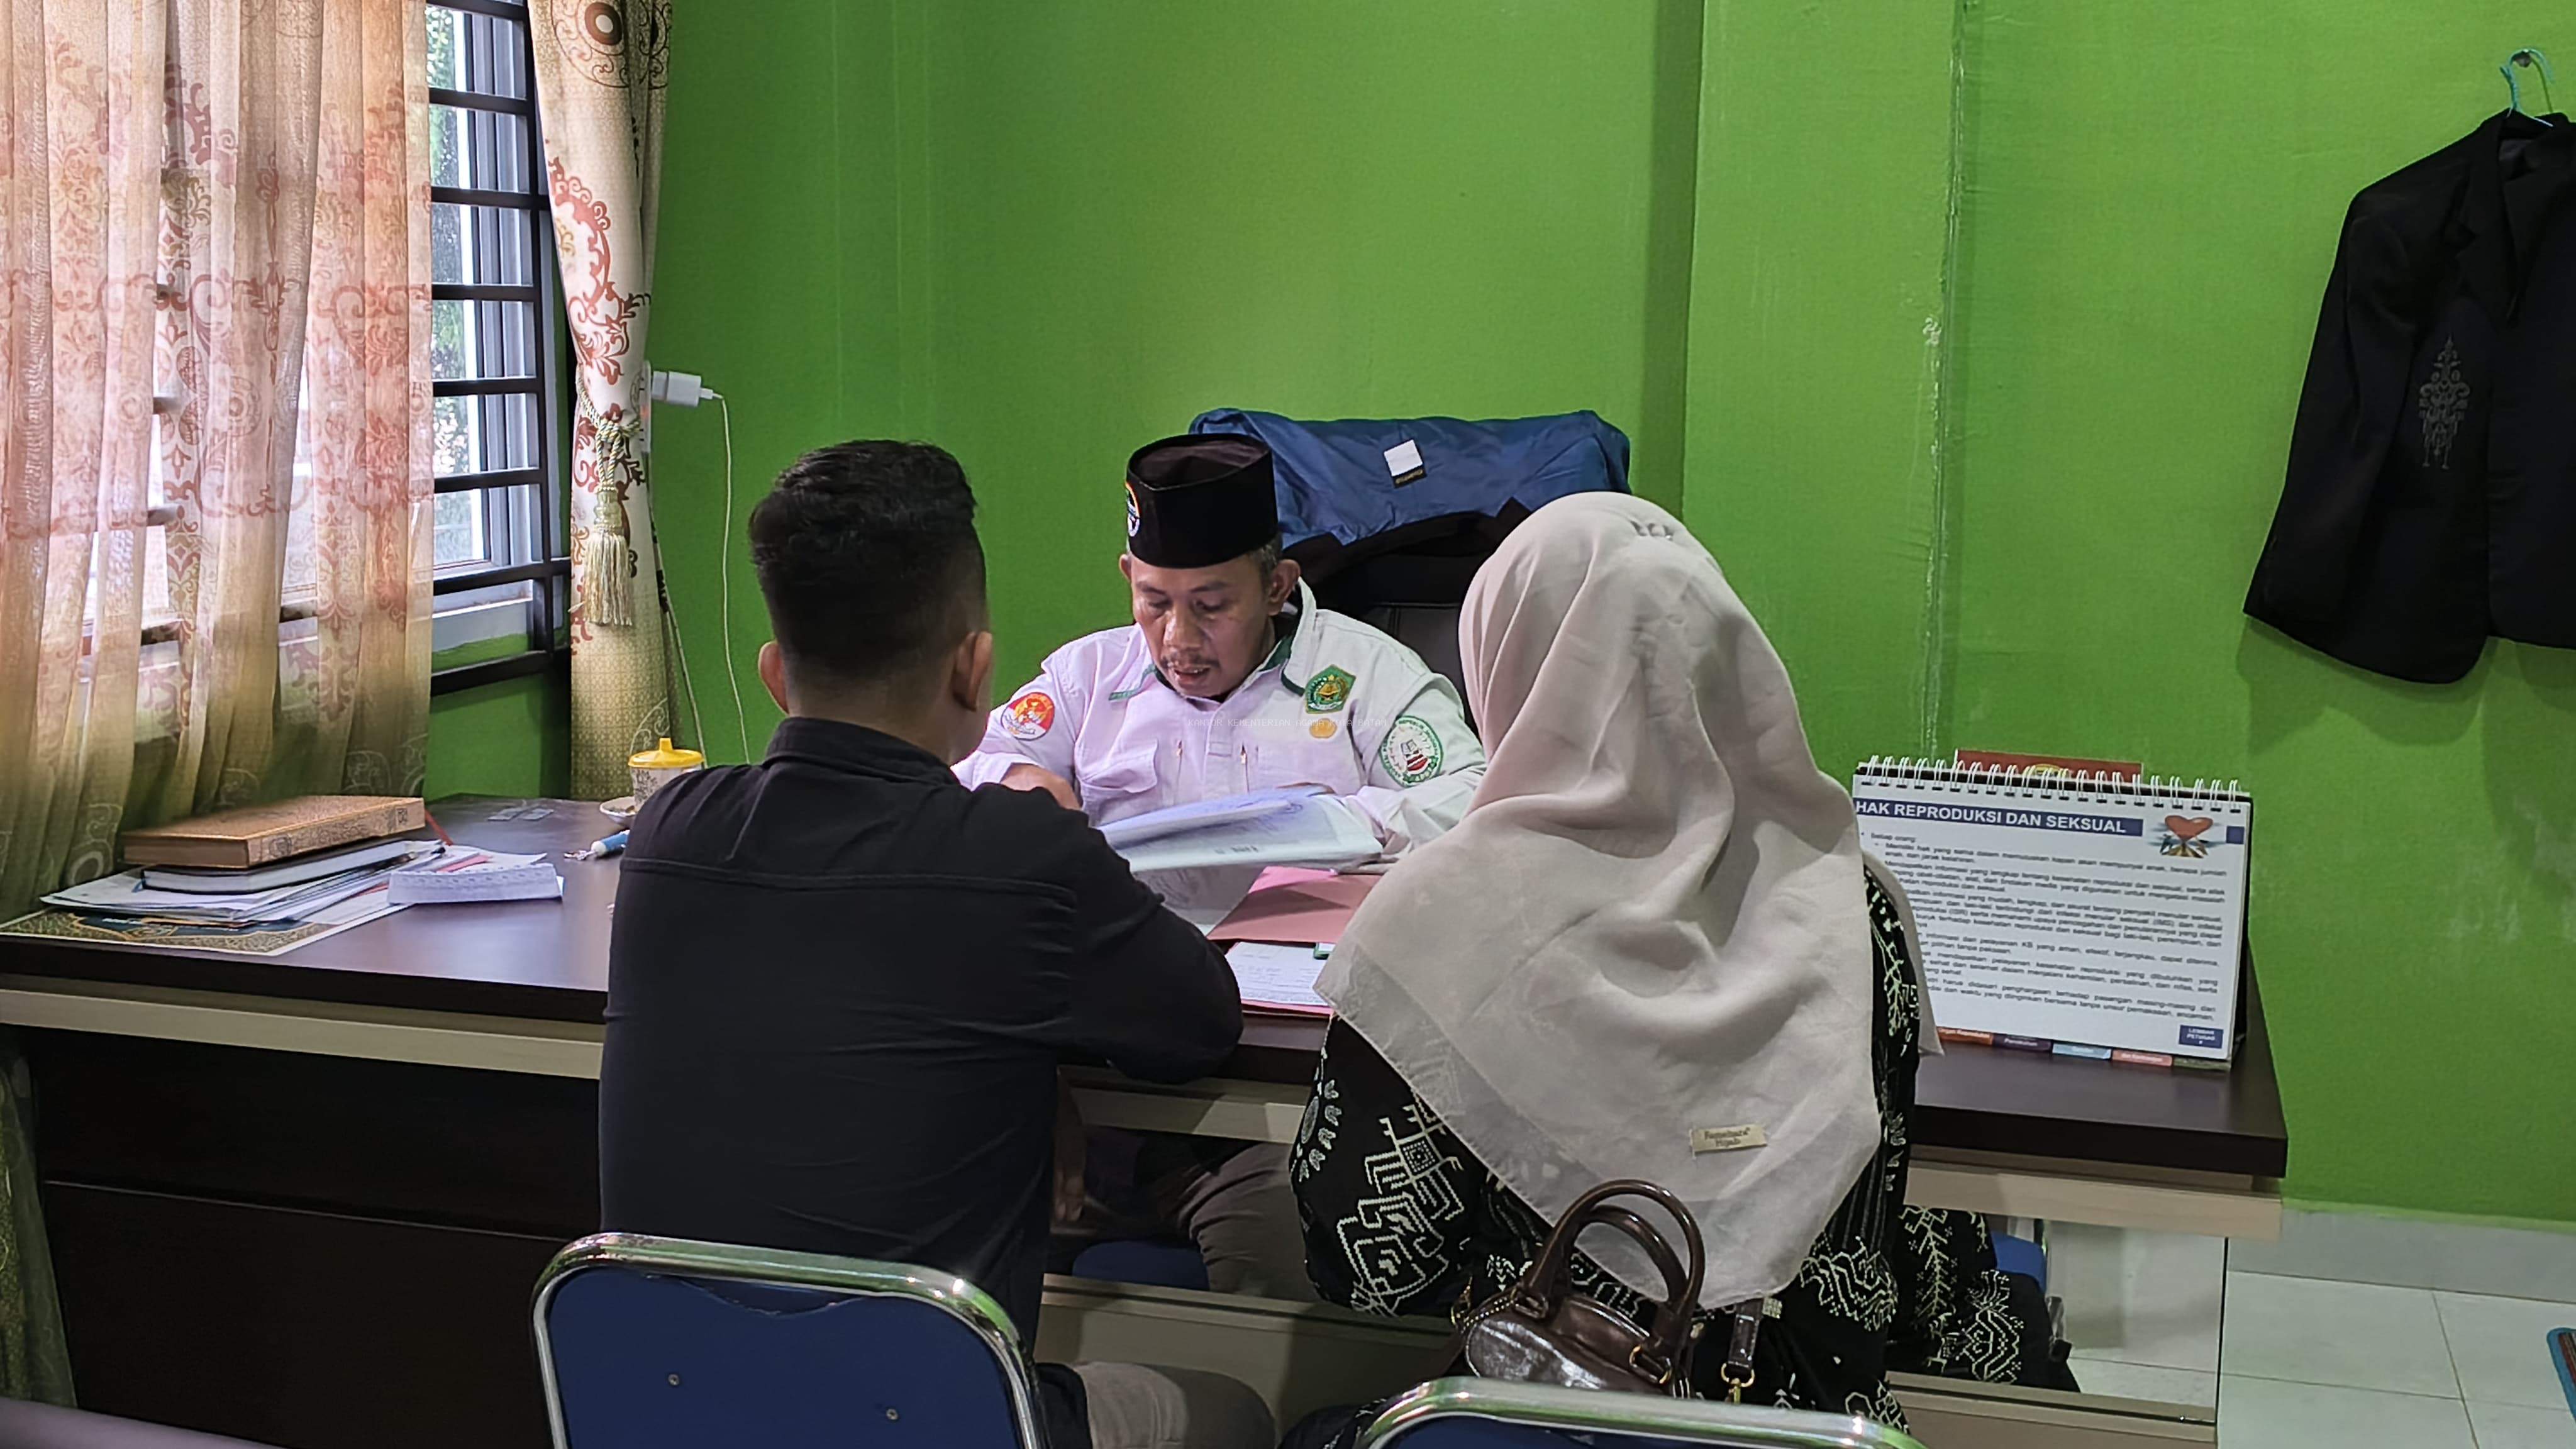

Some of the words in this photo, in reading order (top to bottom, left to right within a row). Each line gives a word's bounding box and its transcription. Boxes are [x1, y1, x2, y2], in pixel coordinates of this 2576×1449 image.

[1856, 801, 1890, 815] HAK
[1894, 803, 2001, 824] REPRODUKSI
[2006, 812, 2041, 827] DAN
[2045, 815, 2126, 834] SEKSUAL
